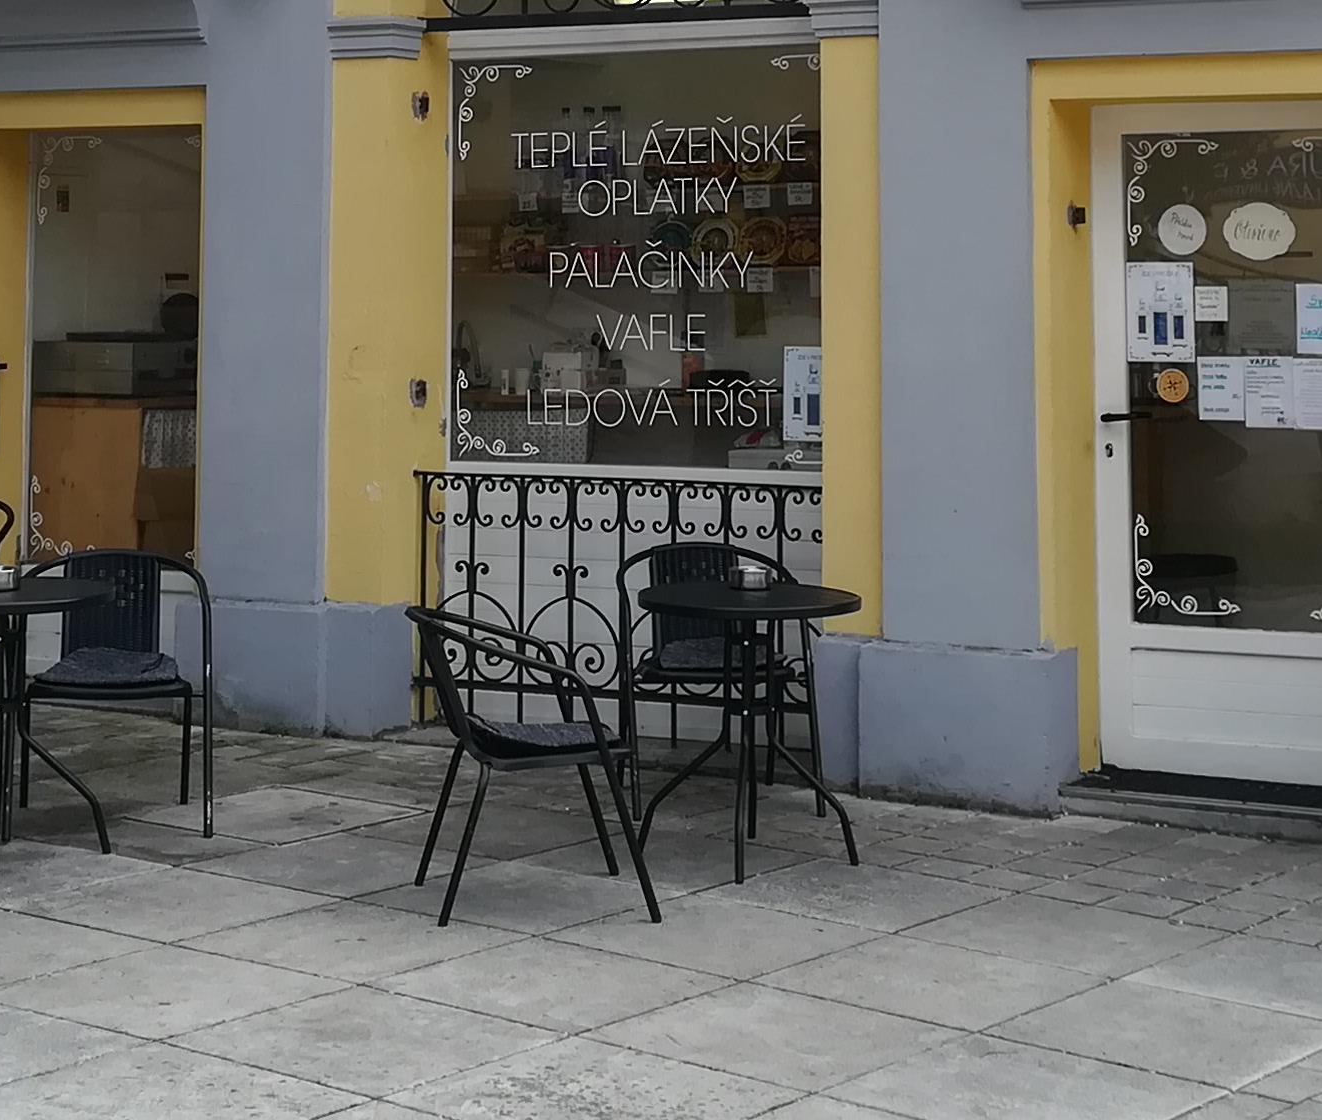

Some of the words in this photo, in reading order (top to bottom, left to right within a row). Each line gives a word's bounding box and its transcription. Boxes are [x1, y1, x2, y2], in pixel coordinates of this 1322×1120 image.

[510, 122, 608, 169] TEPLÉ
[622, 114, 807, 167] LÁZEŇSKÉ
[578, 176, 737, 217] OPLATKY
[549, 239, 754, 289] PALAČINKY
[596, 314, 707, 352] VAFLE
[526, 379, 678, 428] LEDOVÁ
